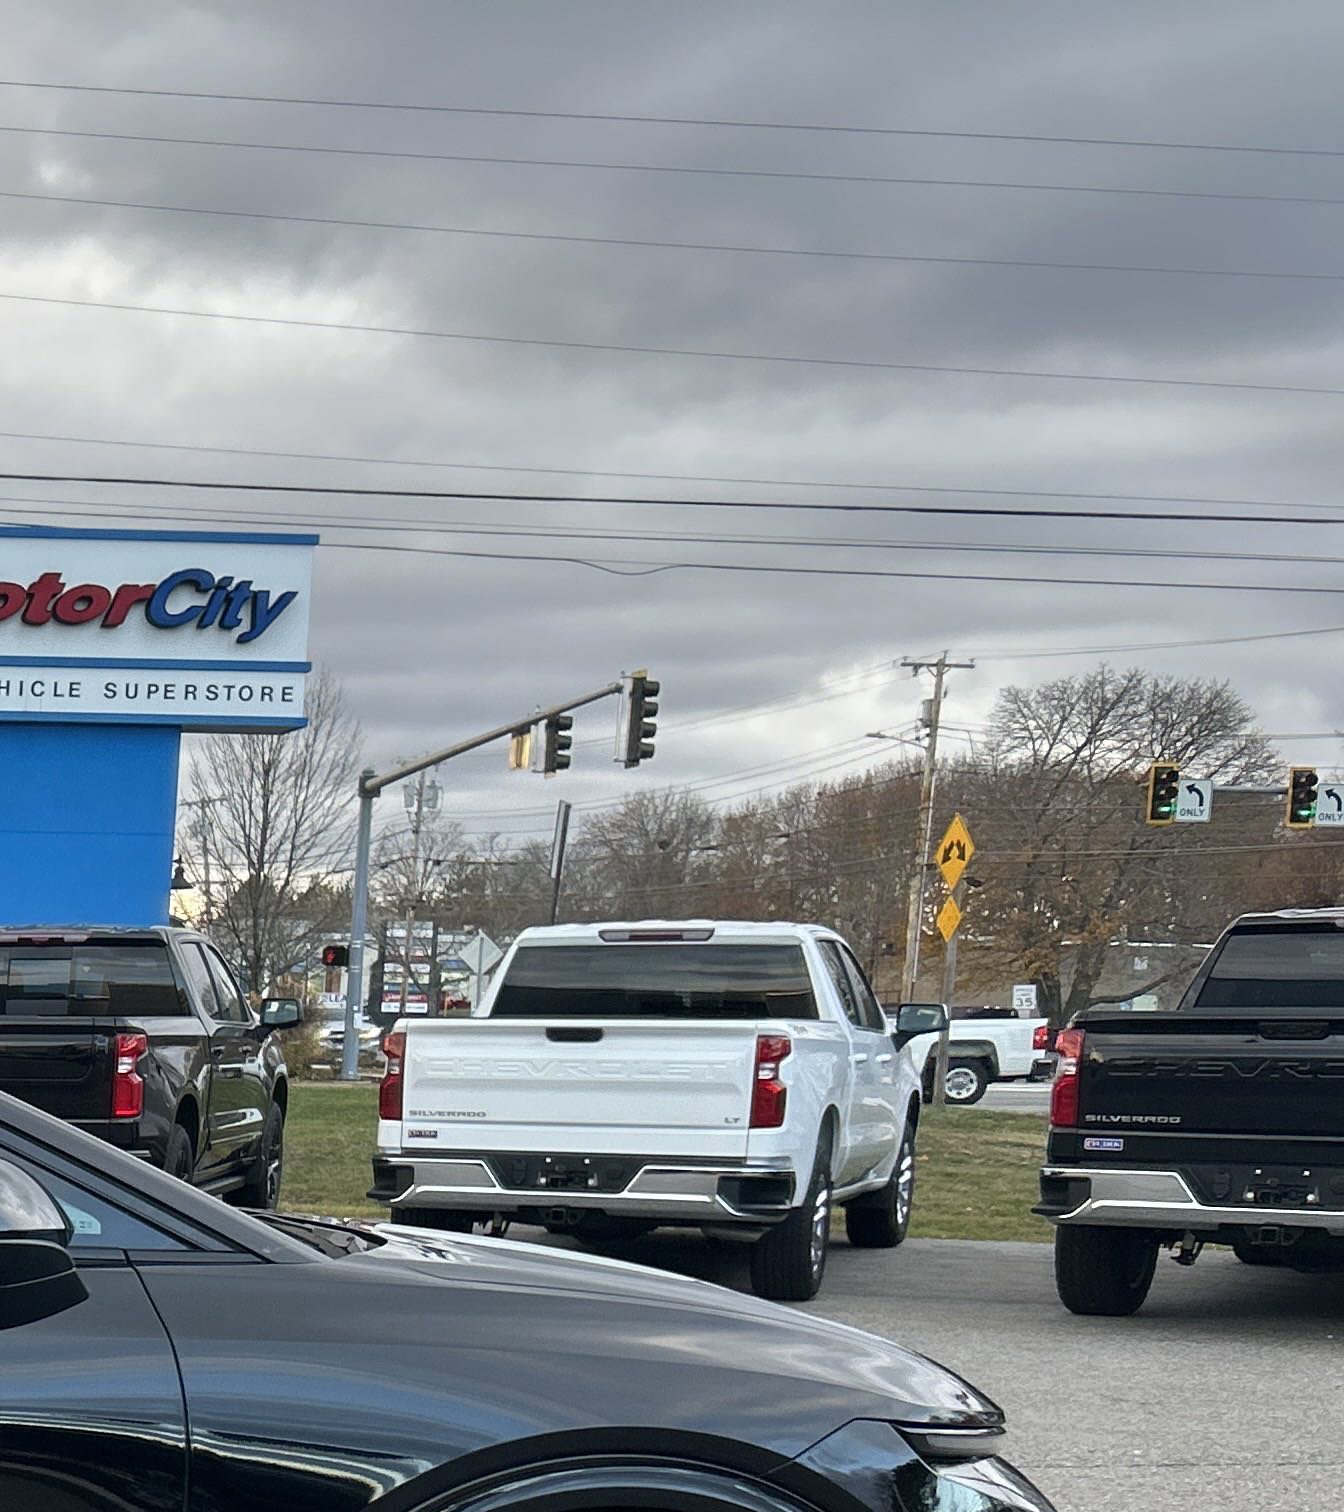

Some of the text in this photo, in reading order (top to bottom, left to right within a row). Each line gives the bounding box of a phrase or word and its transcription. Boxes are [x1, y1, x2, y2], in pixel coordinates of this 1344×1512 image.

[103, 681, 295, 704] SUPERSTORE
[1179, 807, 1207, 817] ONLY
[1318, 812, 1344, 823] ONLY
[1015, 997, 1034, 1007] 35
[424, 1055, 730, 1080] CHEVROLET
[409, 1109, 487, 1118] SILVERADO
[1084, 1113, 1182, 1124] SILVERADO
